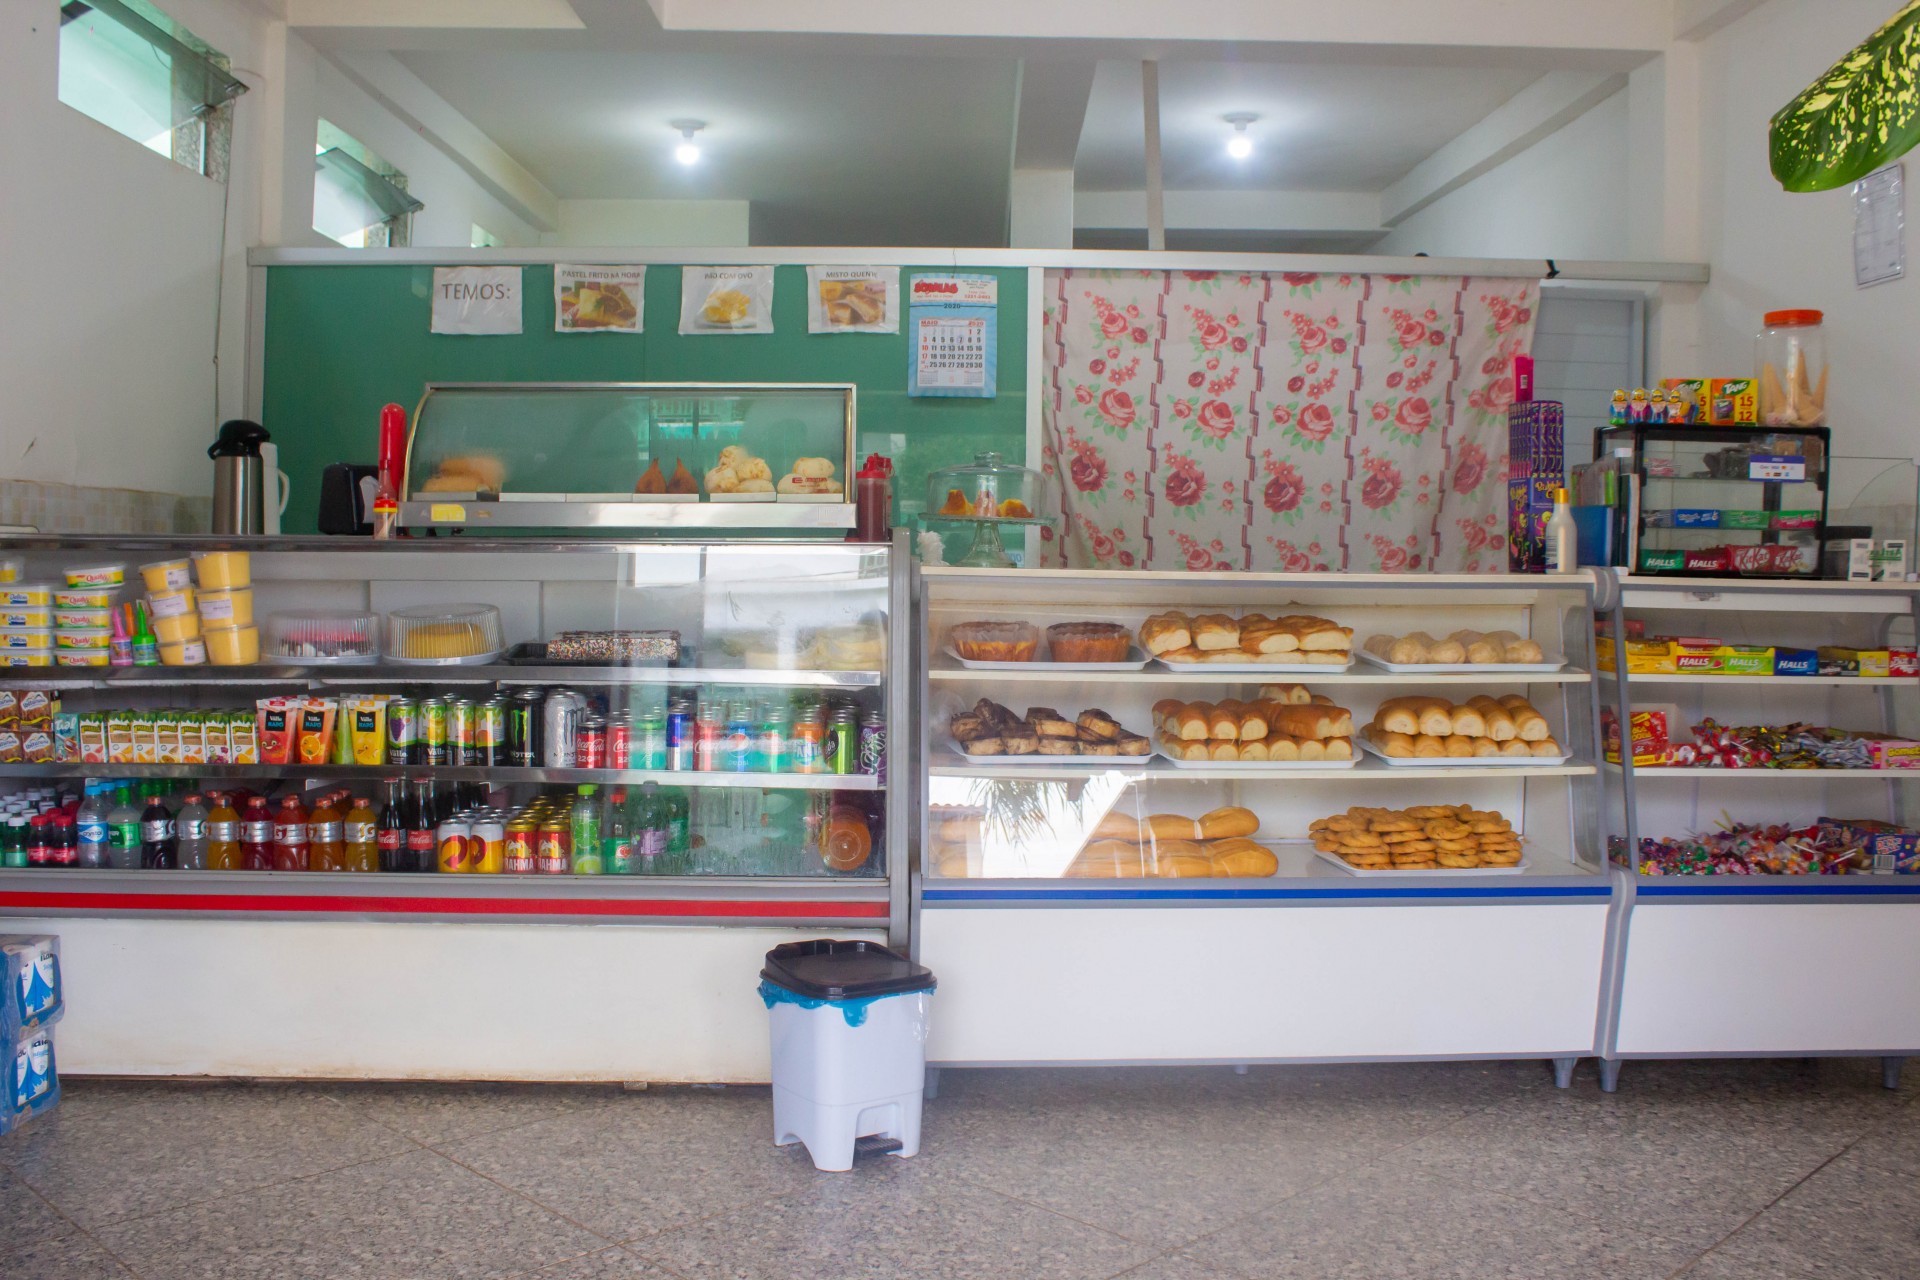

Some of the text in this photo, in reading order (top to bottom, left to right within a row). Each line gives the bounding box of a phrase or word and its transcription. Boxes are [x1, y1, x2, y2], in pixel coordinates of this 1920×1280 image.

[738, 272, 752, 280] OVO
[442, 283, 510, 300] TEMOS:
[1723, 381, 1748, 394] TANG
[1740, 396, 1753, 406] 15
[1739, 411, 1752, 421] 12
[1646, 558, 1675, 566] HALLS
[1688, 560, 1718, 568] HALLS
[1679, 658, 1709, 666] HALLS
[1730, 658, 1759, 666] HALLS
[1779, 660, 1808, 669] HALLS
[56, 717, 76, 730] Tial
